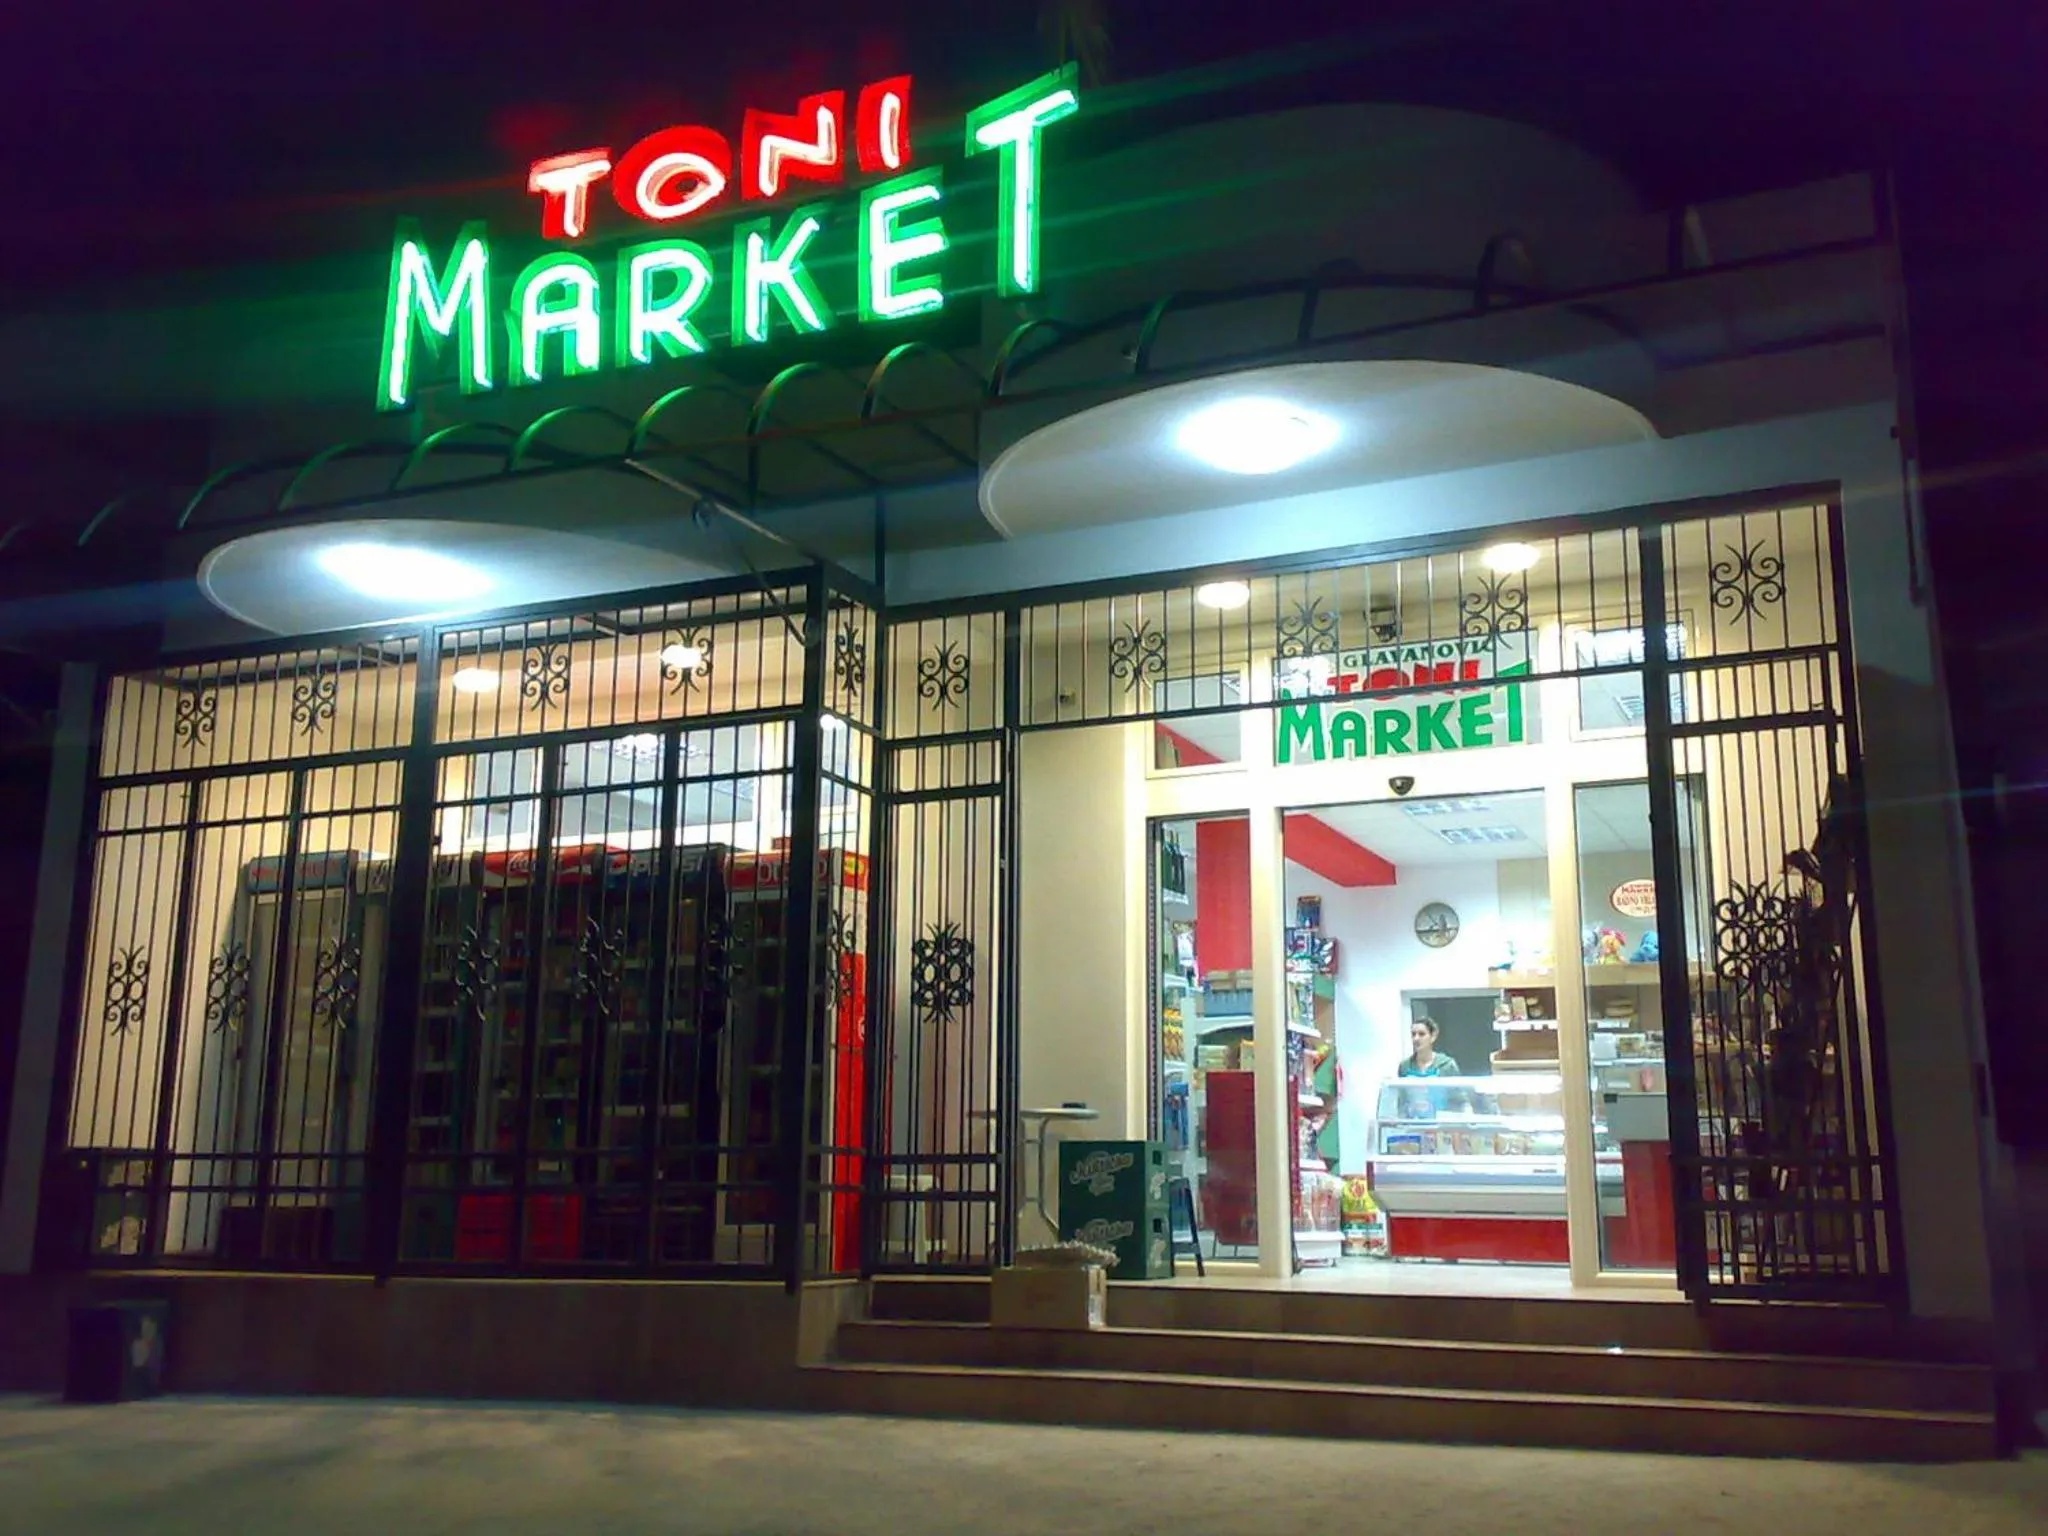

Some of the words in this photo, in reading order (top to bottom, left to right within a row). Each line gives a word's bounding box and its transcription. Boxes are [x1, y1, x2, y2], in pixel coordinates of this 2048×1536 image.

[527, 75, 912, 239] TONI
[375, 63, 1080, 412] MARKET
[1278, 660, 1532, 764] MARKET
[1328, 659, 1481, 702] TONI
